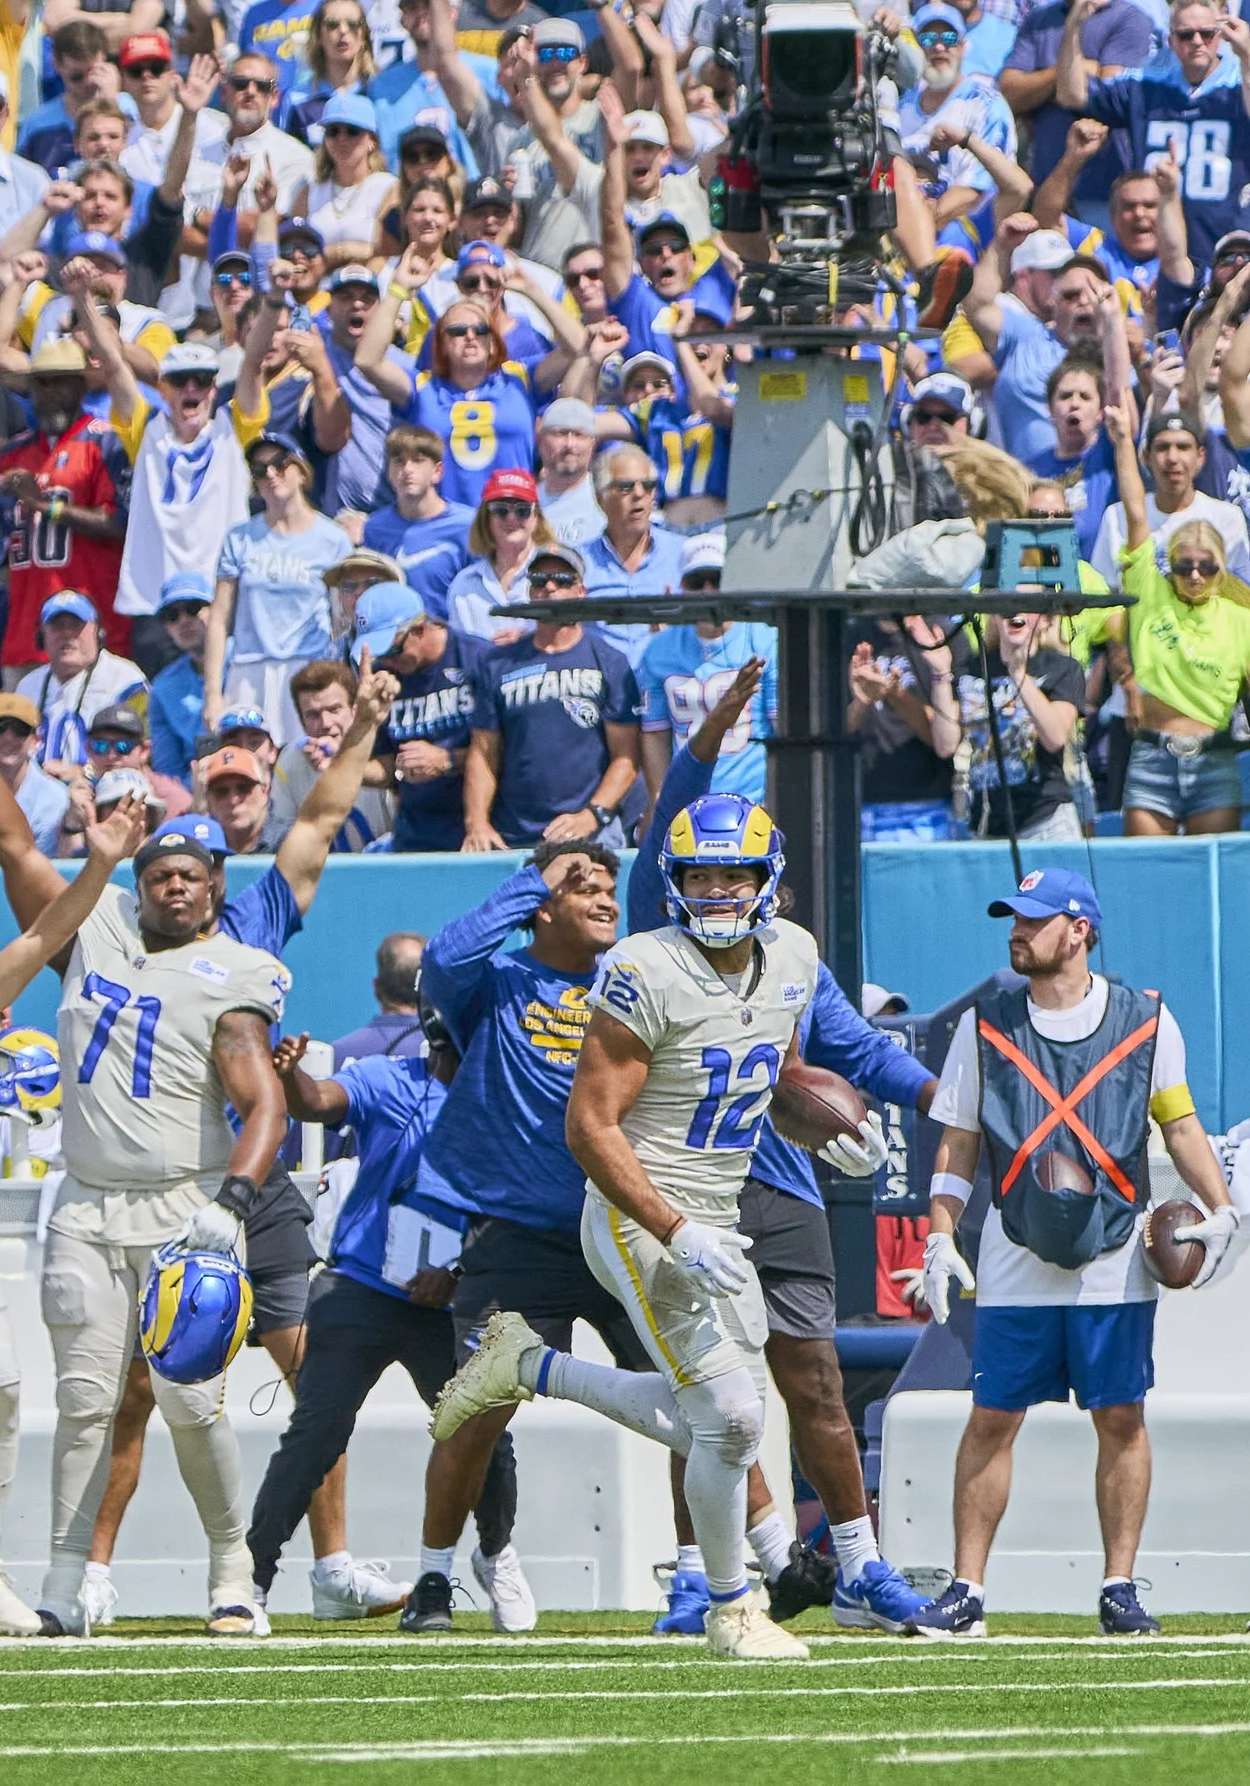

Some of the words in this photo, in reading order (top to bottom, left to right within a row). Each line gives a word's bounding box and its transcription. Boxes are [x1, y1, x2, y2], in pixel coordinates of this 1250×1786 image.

[252, 15, 313, 42] RAM
[1144, 120, 1233, 200] 28
[450, 400, 498, 473] 8
[661, 423, 714, 498] 17
[500, 668, 602, 708] TITANS
[704, 841, 730, 849] RAMS
[526, 1003, 591, 1024] ENGINEER
[599, 969, 639, 1014] 12
[77, 970, 163, 1098] 71
[546, 1020, 584, 1037] ANGEL
[686, 1042, 781, 1149] 12
